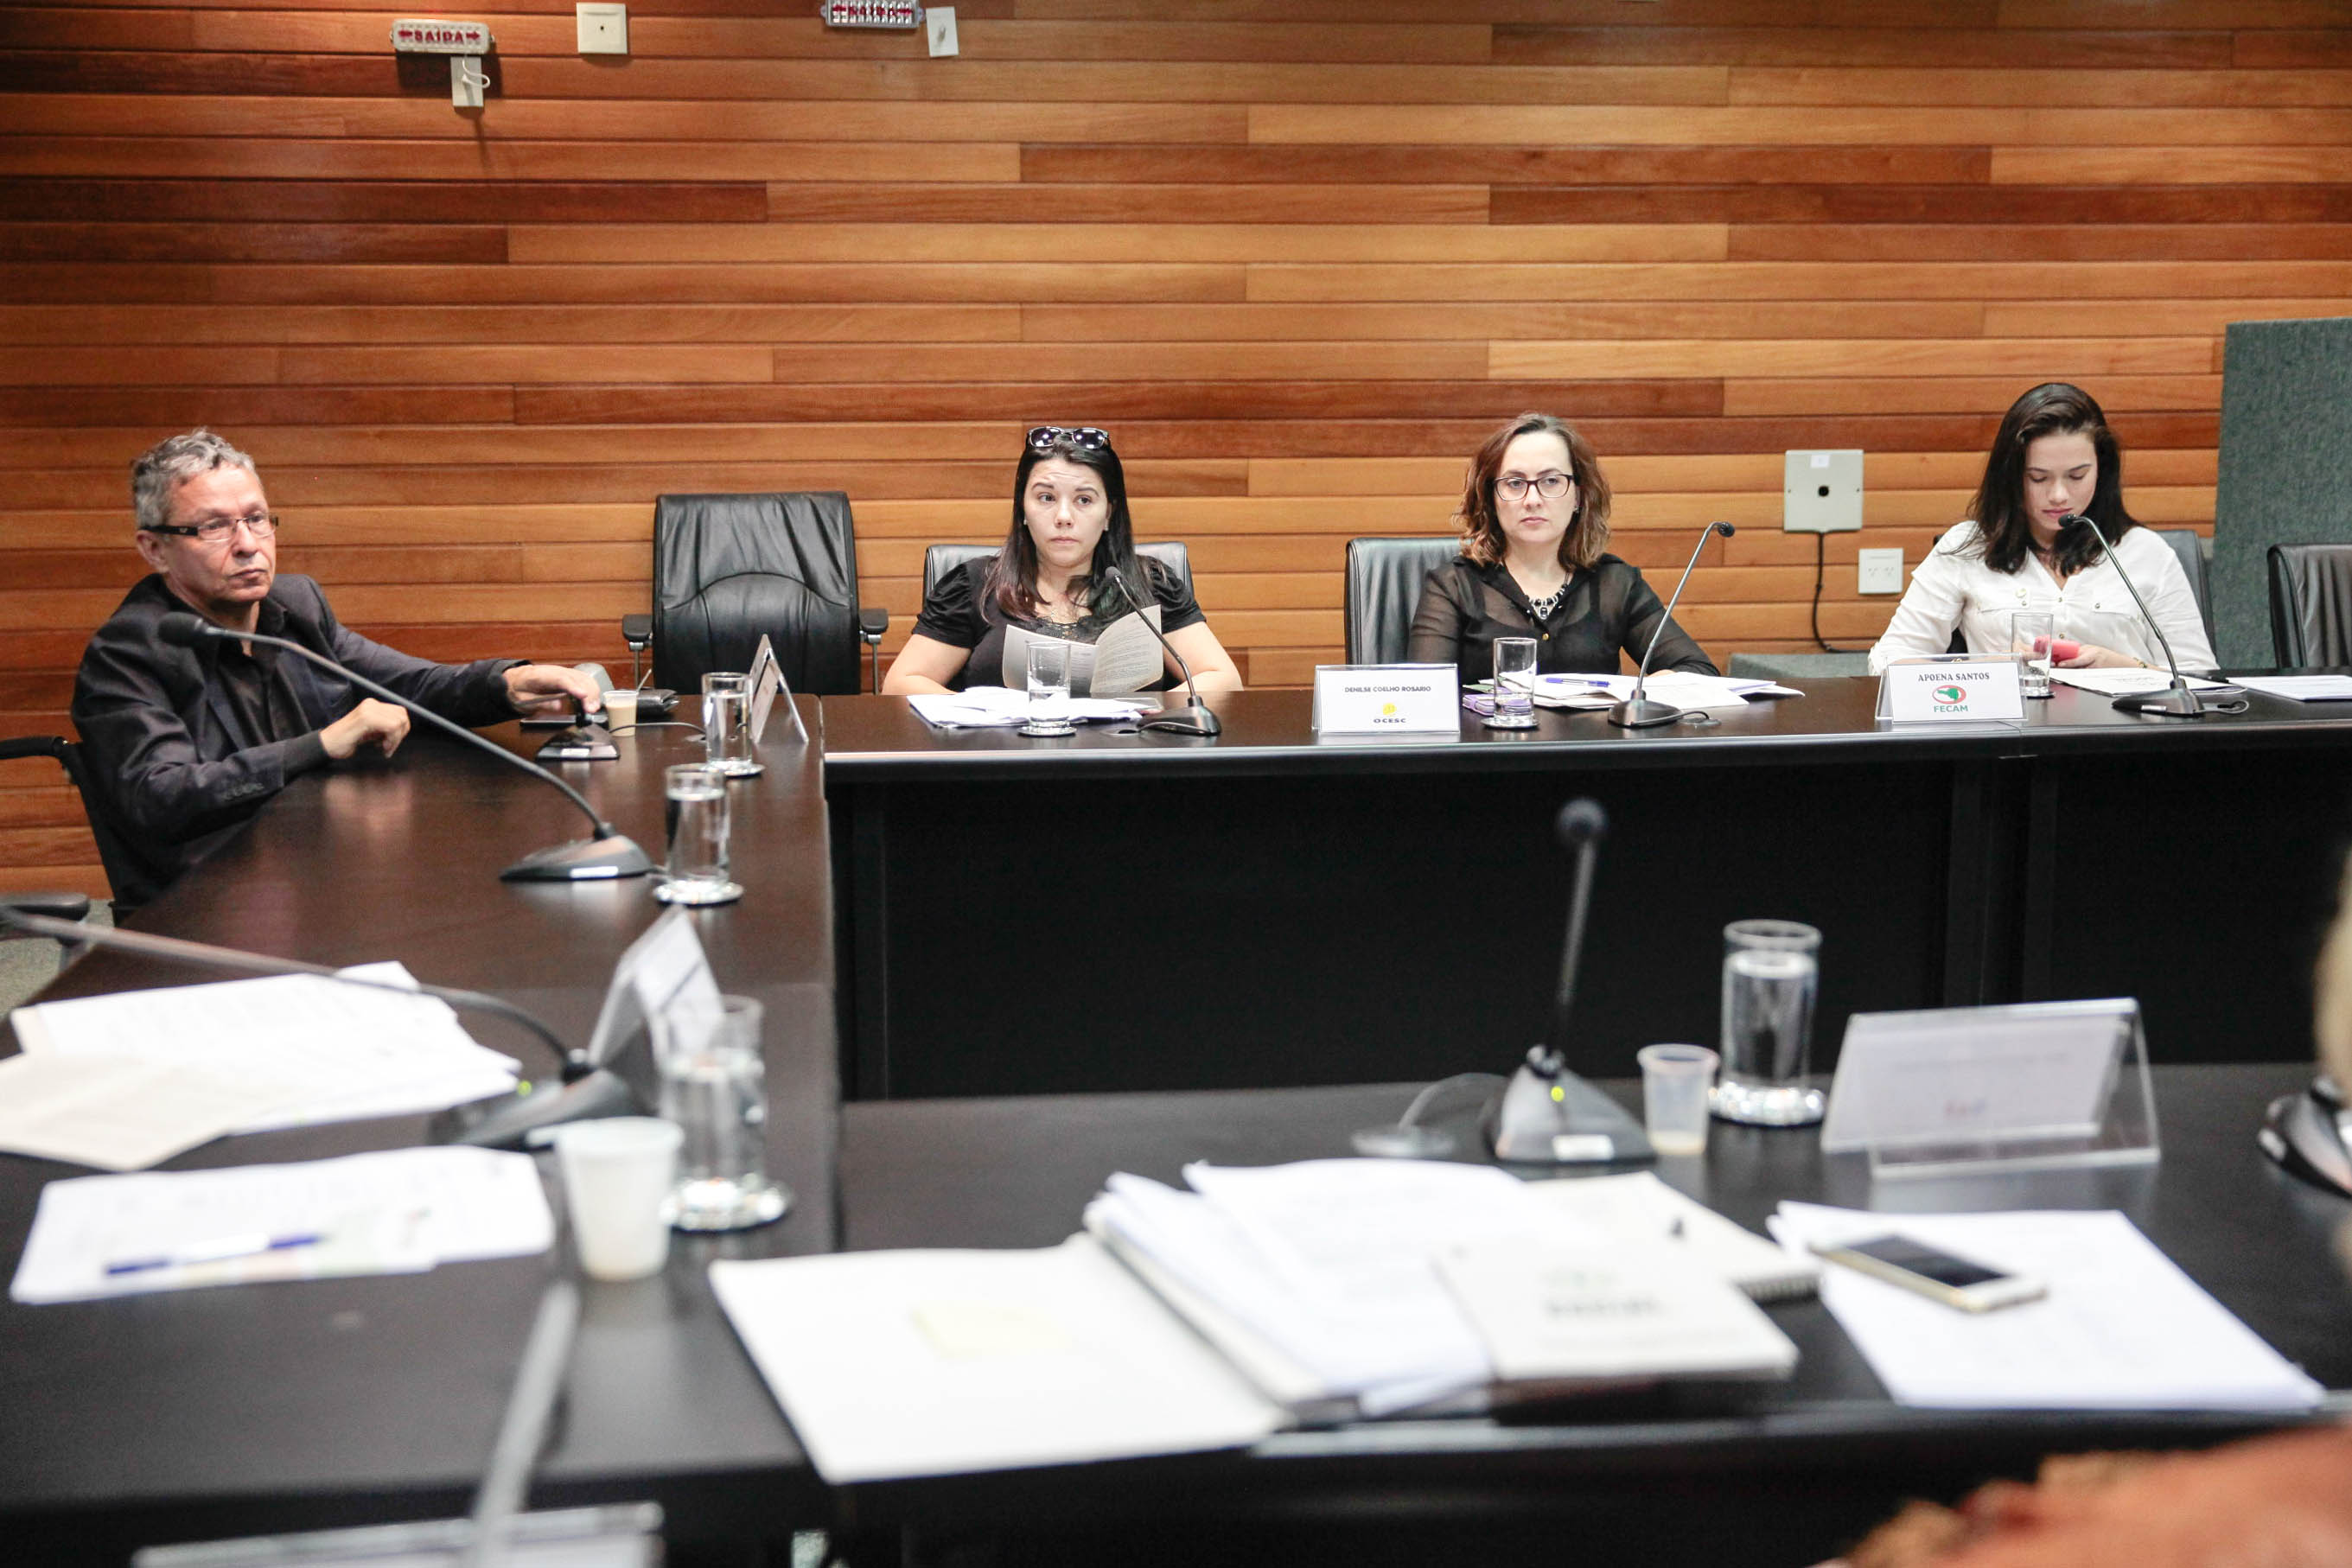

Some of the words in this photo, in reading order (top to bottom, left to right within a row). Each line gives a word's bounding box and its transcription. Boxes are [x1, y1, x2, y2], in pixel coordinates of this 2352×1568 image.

[1918, 672, 1954, 682] APOENA
[1955, 672, 1990, 681] SANTOS
[1934, 704, 1969, 713] FECAM
